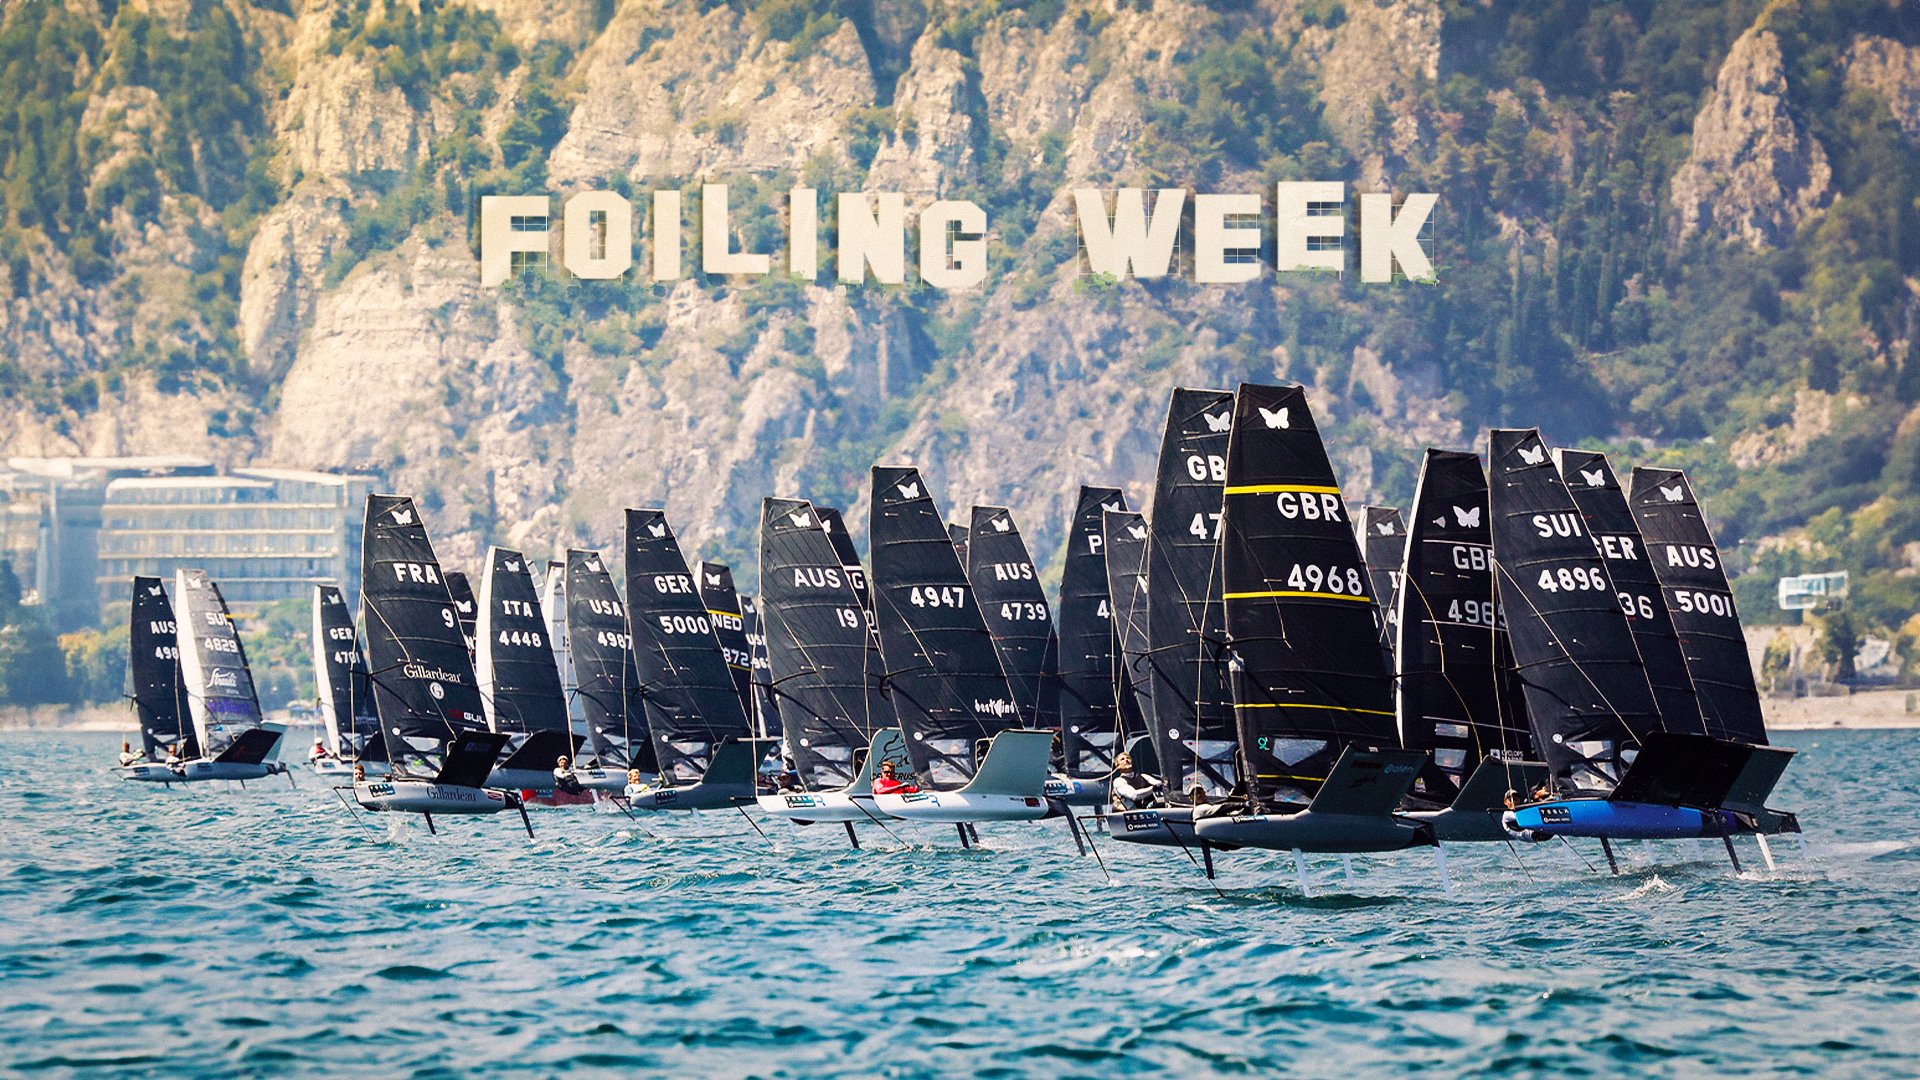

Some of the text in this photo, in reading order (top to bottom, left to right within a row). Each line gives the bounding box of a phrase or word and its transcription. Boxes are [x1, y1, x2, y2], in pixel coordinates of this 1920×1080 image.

[481, 181, 1440, 288] FOILING WEEK
[1277, 492, 1341, 522] GBR
[1532, 513, 1582, 538] SUI
[1666, 545, 1716, 569] AUS
[393, 563, 439, 584] FRA
[794, 568, 841, 588] AUS
[995, 564, 1032, 581] AUS
[1288, 564, 1362, 595] 4968
[1538, 567, 1606, 592] 4896
[654, 575, 692, 593] GER
[911, 587, 964, 608] 4947
[1675, 591, 1732, 617] 5001
[441, 608, 454, 628] 9
[502, 600, 533, 617] ITA
[589, 600, 623, 617] USA
[836, 608, 858, 628] 19
[1001, 603, 1047, 621] 4739
[151, 621, 177, 634] AUS
[206, 612, 228, 626] SUI
[659, 616, 709, 635] 5000
[711, 613, 742, 631] NED
[330, 627, 353, 640] GER
[499, 631, 541, 648] 4448
[598, 631, 632, 650] 4987
[204, 637, 239, 653] 4829
[403, 664, 461, 683] Gillardeau
